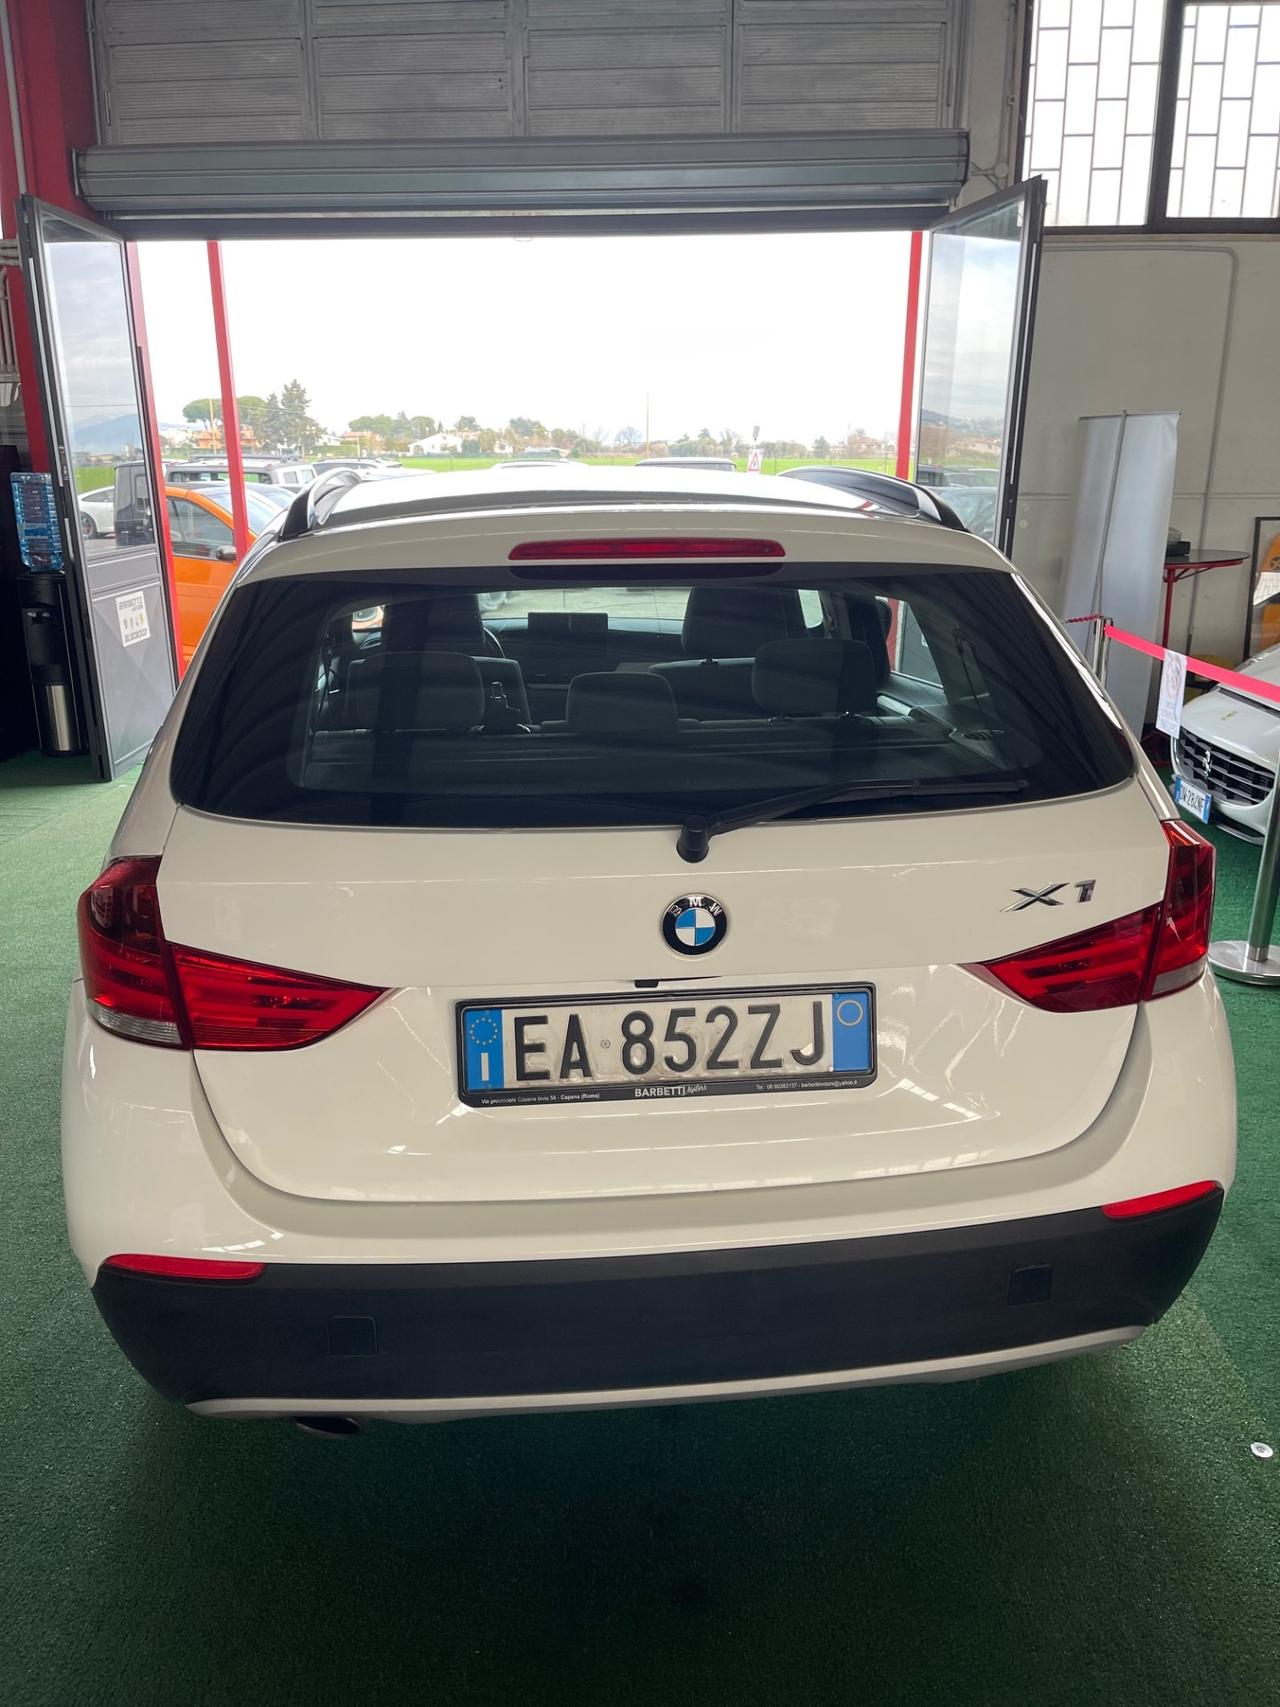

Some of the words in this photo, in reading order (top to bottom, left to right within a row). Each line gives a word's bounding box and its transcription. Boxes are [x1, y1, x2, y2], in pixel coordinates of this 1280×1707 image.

[668, 896, 722, 917] BMW
[1000, 880, 1096, 912] X1
[514, 1013, 593, 1081] EA
[621, 1001, 824, 1075] 852ZJ
[634, 1086, 686, 1097] BARBETTI
